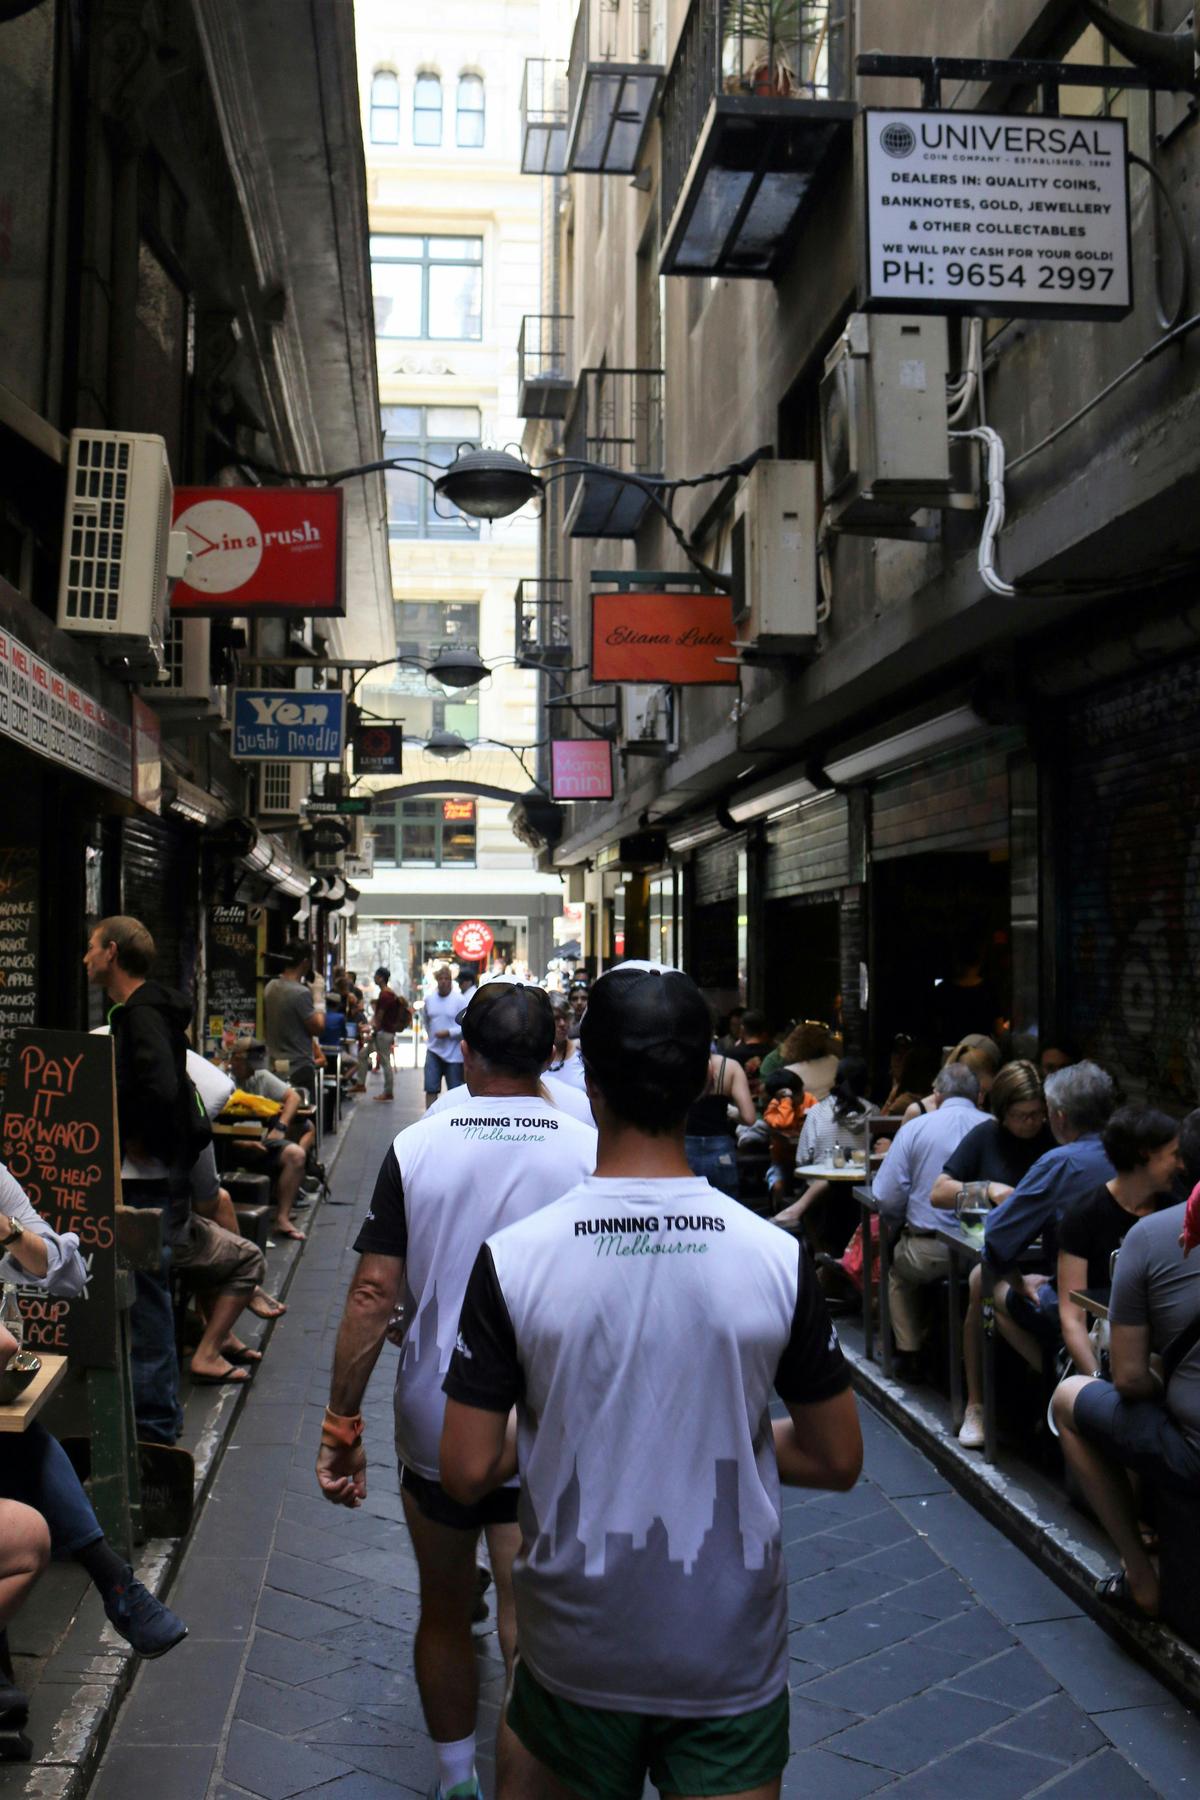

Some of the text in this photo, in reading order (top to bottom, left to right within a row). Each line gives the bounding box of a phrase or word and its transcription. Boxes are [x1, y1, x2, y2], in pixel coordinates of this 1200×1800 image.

[920, 122, 1112, 156] UNIVERSAL
[922, 153, 949, 162] COIN
[952, 154, 1001, 164] COMPANY
[891, 172, 1102, 193] DEALERS IN: QUALITY COINS,
[880, 195, 1112, 215] BANKNOTES, GOLD, JEWELLERY
[908, 220, 1087, 238] & OTHER COLLECTABLES
[882, 243, 1114, 262] WE WILL PAY CASH FOR YOUR GOLD!
[882, 260, 1115, 291] PH: 9654 2997
[221, 533, 243, 551] in
[246, 535, 259, 548] a
[263, 520, 321, 548] rush
[605, 625, 672, 646] Eliana
[12, 647, 29, 676] MEL
[32, 662, 48, 689] MEL
[51, 676, 66, 701] MEL
[11, 670, 29, 701] BURN
[32, 685, 49, 715] BURN
[51, 699, 66, 727] BURN
[247, 697, 329, 726] Yen
[12, 701, 28, 737] BUG
[32, 714, 48, 748] BUG
[236, 725, 280, 752] Sushi
[556, 771, 609, 792] mini
[0, 900, 36, 916] RANGE
[212, 905, 246, 917] Bella
[7, 971, 35, 987] APPLE
[19, 1044, 85, 1093] PAY
[32, 1088, 66, 1118] IT
[3, 1113, 100, 1155] FORWARD
[449, 1117, 559, 1130] RUNNING TOURS
[463, 1126, 547, 1142] Melbourne
[37, 1164, 102, 1187] TO HELP
[51, 1186, 88, 1212] THE
[574, 1215, 726, 1237] RUNNING TOURS
[594, 1233, 710, 1257] Melbourne
[18, 1299, 70, 1322] SOUP
